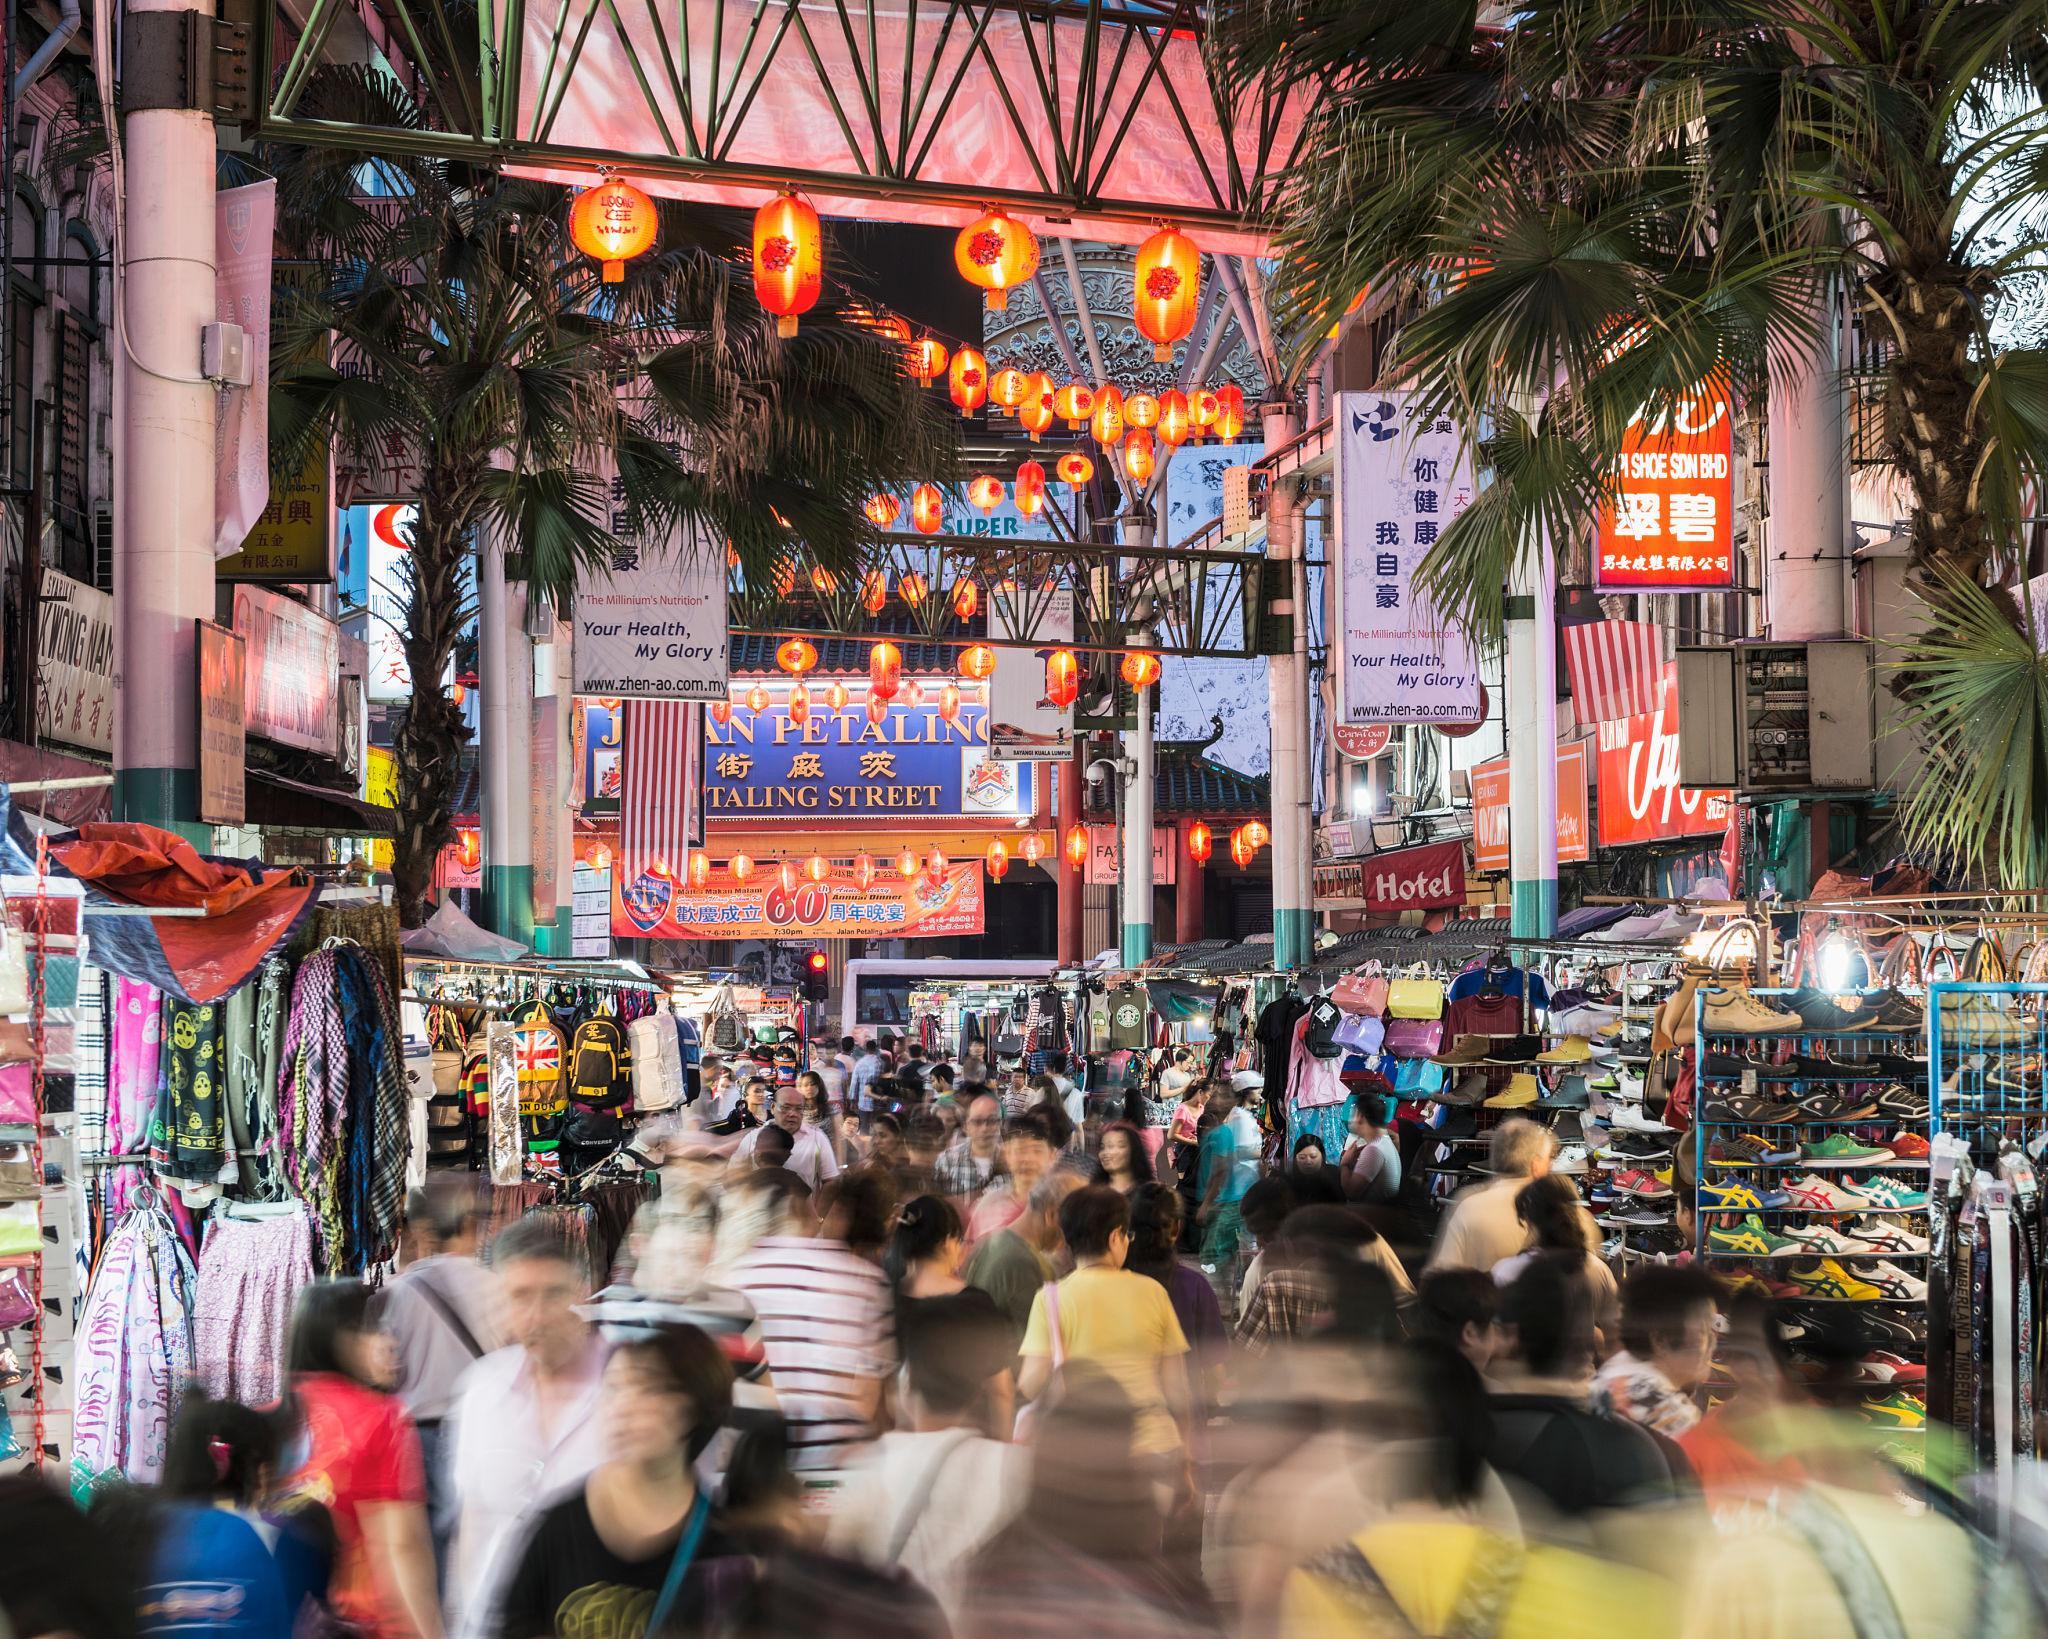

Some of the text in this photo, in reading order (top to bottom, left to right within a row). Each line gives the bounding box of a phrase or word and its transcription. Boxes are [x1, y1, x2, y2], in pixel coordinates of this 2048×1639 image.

[1631, 453, 1667, 479] SHOE
[1670, 453, 1698, 479] SDN
[1700, 453, 1728, 479] BHD
[1414, 458, 1438, 545] 你健康
[255, 532, 285, 548] 五金
[240, 553, 299, 569] 有限公司
[1375, 521, 1400, 608] 我自豪
[586, 595, 703, 606] The Millinium's Nutrition
[38, 603, 87, 668] KWONG
[583, 622, 691, 639] Your Health,
[1354, 629, 1455, 639] The Millinium's Nutrition
[635, 644, 660, 661] My
[666, 643, 713, 661] Glory
[1352, 654, 1445, 670] Your Health,
[583, 676, 728, 695] www.zhen-ao.com.my
[1397, 673, 1418, 688] My
[1424, 673, 1465, 688] Glory
[1352, 703, 1479, 719] www.zhen-ao.com.my
[828, 785, 943, 807] STREET
[1375, 866, 1454, 902] Hotel
[676, 905, 762, 924] 歡慶成立
[829, 903, 904, 921] 周年晚宴
[773, 928, 803, 936] 7:30pm
[836, 928, 855, 936] Jalan
[856, 928, 884, 936] Petaling
[581, 1138, 613, 1146] CONVERSE
[1954, 1257, 1971, 1340] TIMBERLAND
